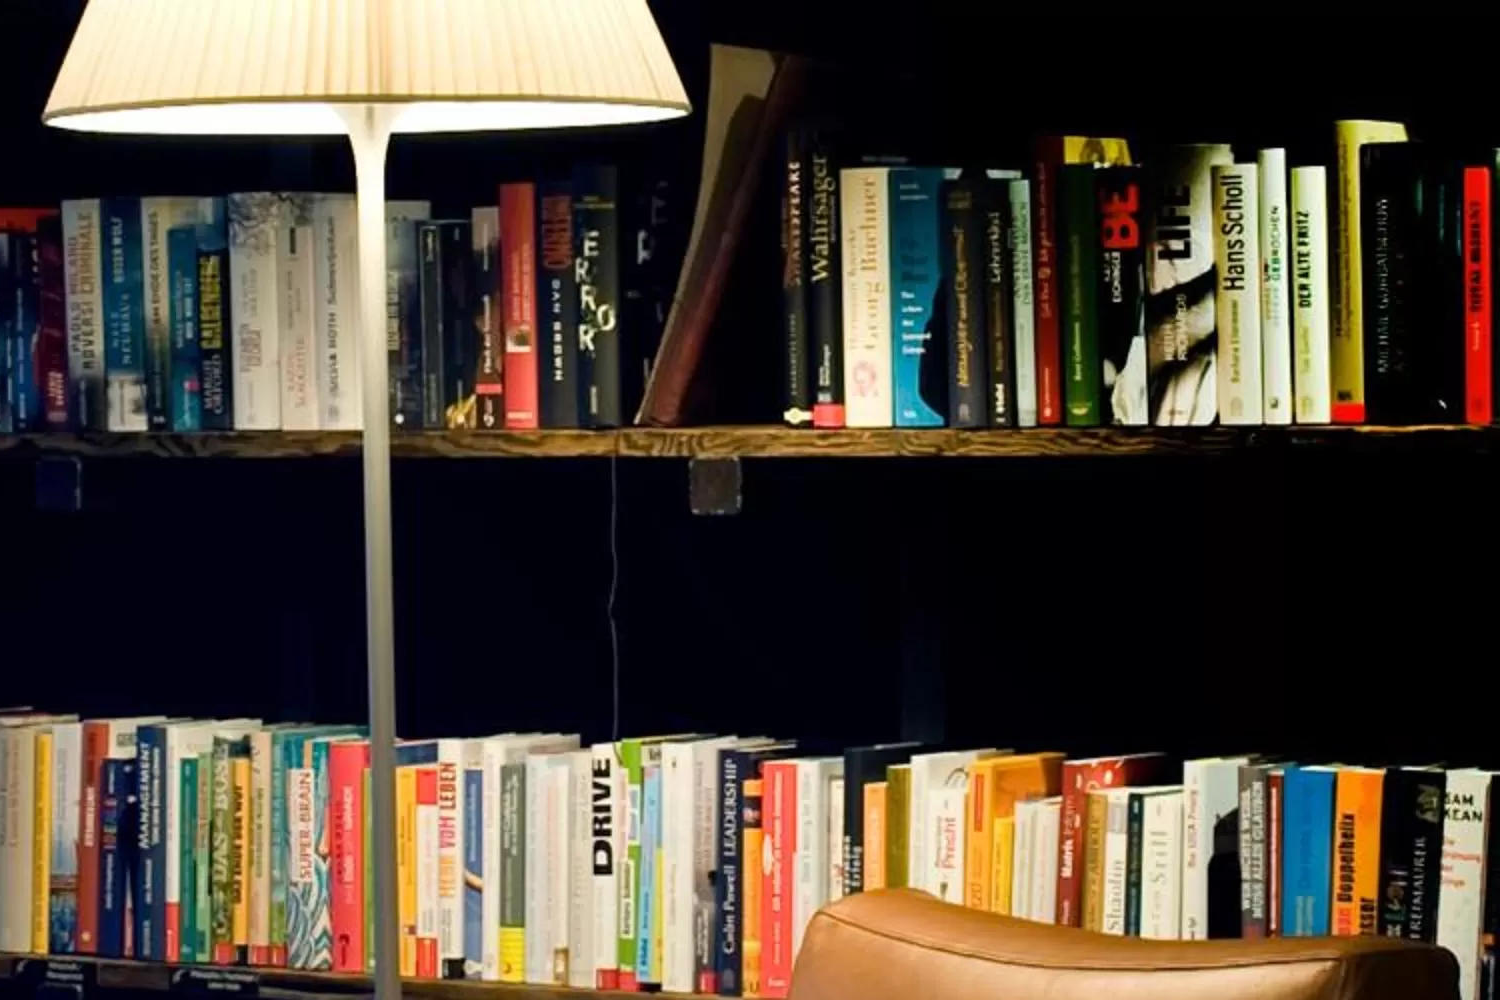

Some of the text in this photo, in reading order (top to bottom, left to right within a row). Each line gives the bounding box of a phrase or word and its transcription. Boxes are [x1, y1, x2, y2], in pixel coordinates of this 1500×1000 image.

[788, 161, 801, 287] SHAKESPEARE
[810, 155, 835, 282] Wahrsager
[1102, 184, 1139, 248] BE
[1156, 186, 1191, 260] LIFE
[1220, 174, 1245, 291] Hans Scholl
[77, 212, 95, 369] ROVERSI CRIMINALE
[1295, 210, 1312, 308] DER ALTE FRITZ
[70, 302, 81, 353] PAOLO
[119, 292, 133, 365] NEUHAUS
[551, 279, 564, 381] DAN BROWN
[864, 281, 885, 349] Georg
[1176, 294, 1187, 361] RICHARDS
[1377, 316, 1389, 373] MICHAIL
[139, 742, 151, 849] MANAGEMENT
[438, 762, 457, 810] LEBEN
[592, 757, 613, 876] DRIVE
[1443, 808, 1483, 823] KEAN
[1444, 791, 1474, 806] SAM
[213, 831, 228, 882] DAS
[438, 816, 456, 849] VOM
[722, 757, 737, 954] Colin Powell LEADERSHIP
[851, 846, 863, 887] Erfolg
[942, 817, 957, 869] Precht
[1337, 813, 1356, 904] Doppelhelix
[1105, 860, 1125, 932] Shaolin
